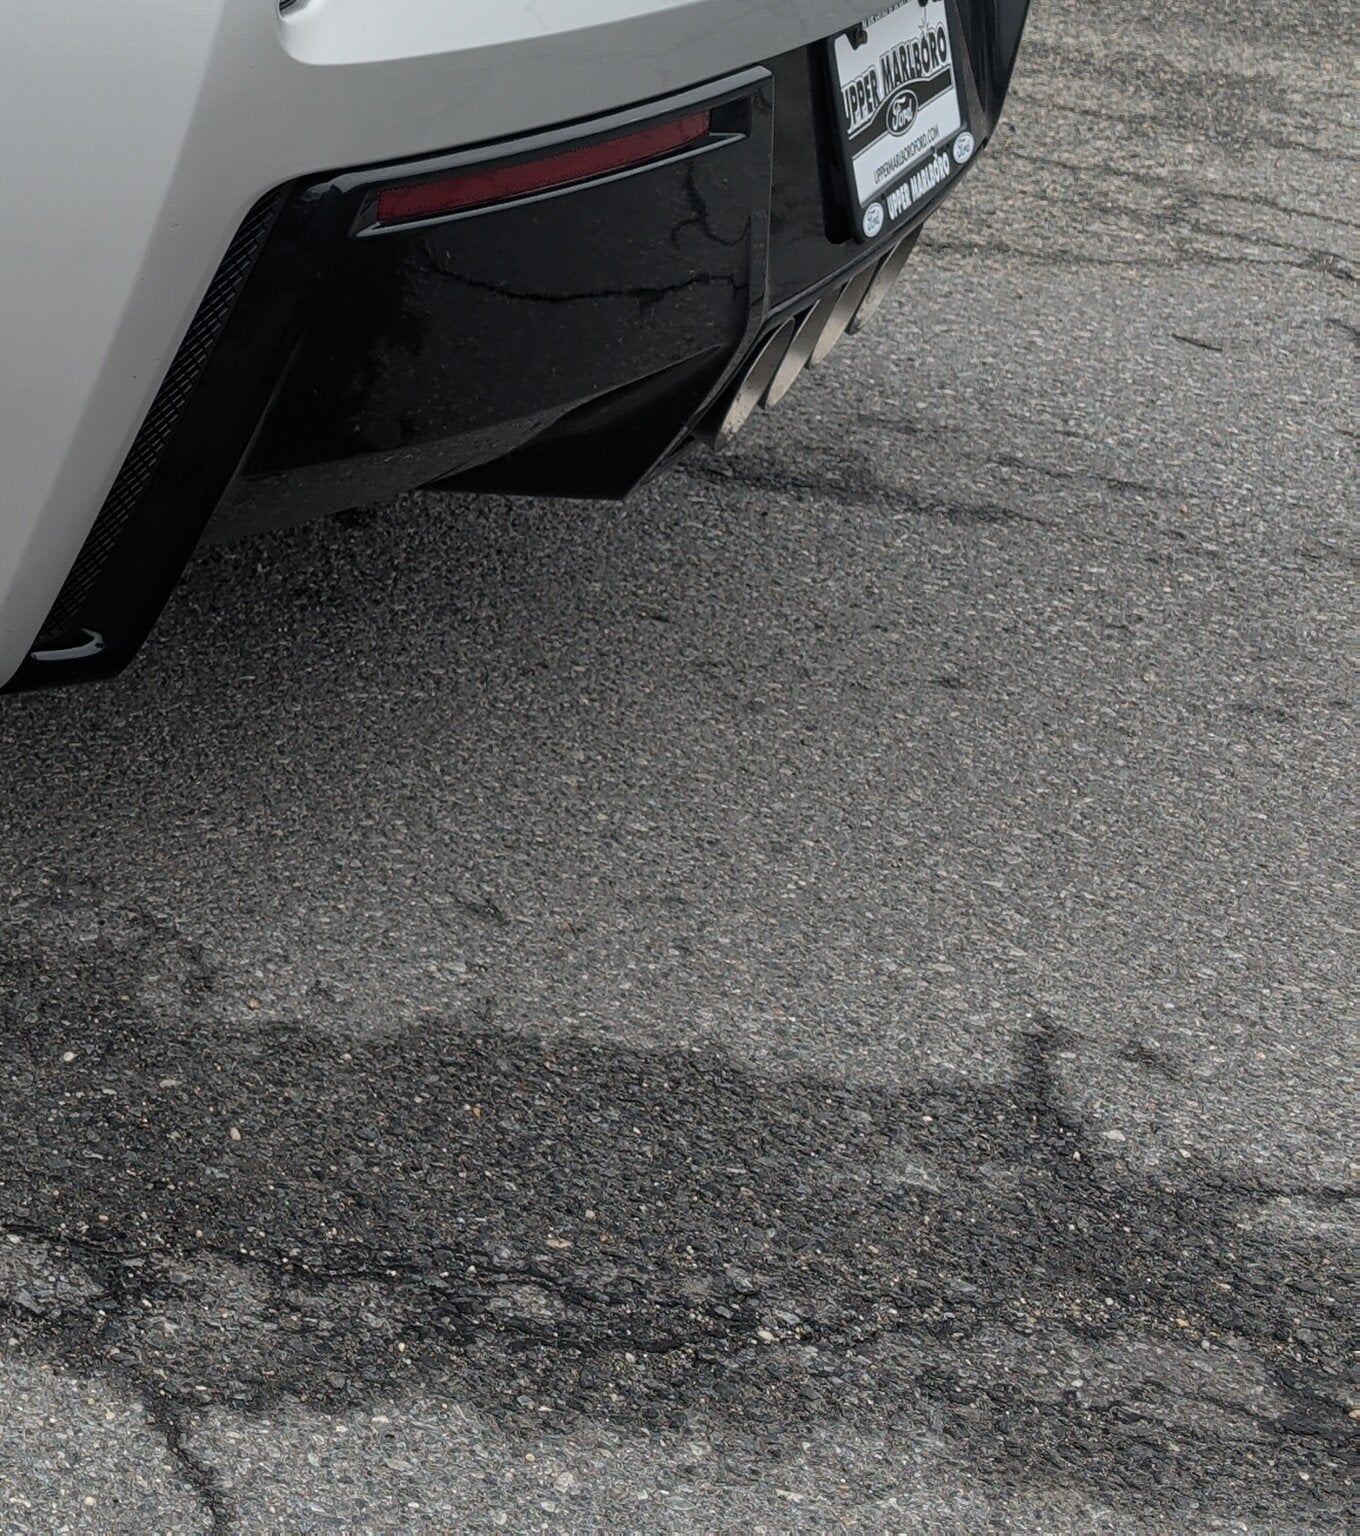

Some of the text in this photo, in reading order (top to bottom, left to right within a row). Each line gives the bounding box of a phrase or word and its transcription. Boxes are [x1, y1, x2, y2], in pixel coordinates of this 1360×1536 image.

[880, 24, 948, 98] MARLBORO
[886, 151, 951, 221] UPPER MARLBORO
